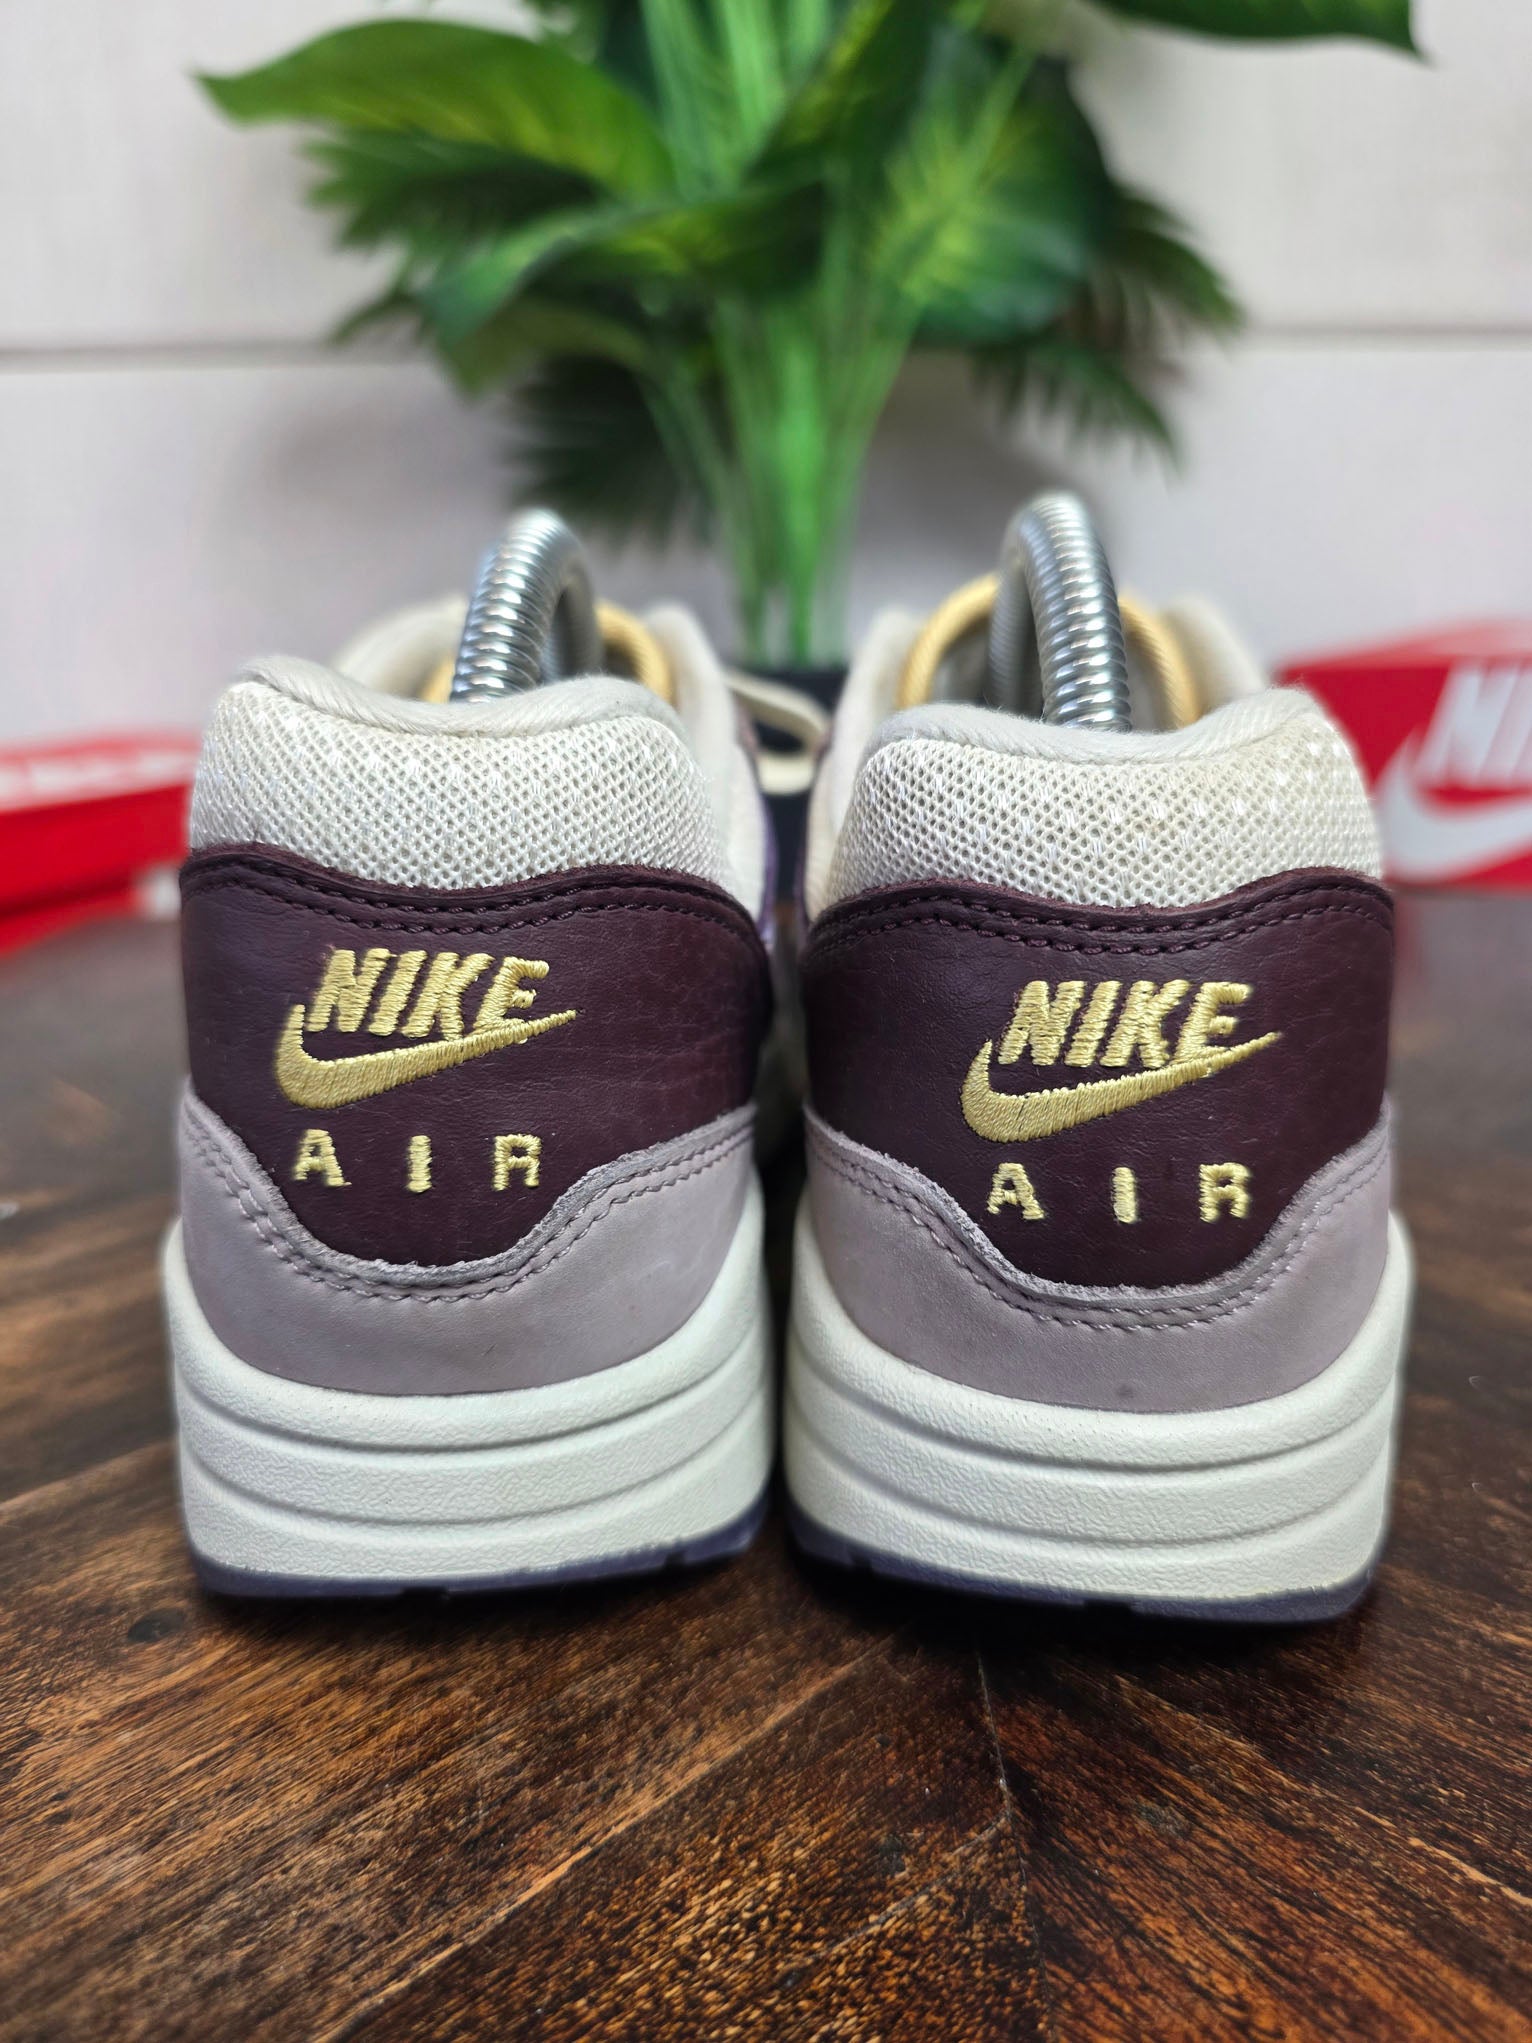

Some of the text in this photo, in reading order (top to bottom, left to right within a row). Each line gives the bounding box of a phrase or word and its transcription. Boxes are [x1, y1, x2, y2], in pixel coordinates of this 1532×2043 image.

[305, 947, 549, 1040] NIKE
[997, 978, 1251, 1067] NIKE
[293, 1128, 542, 1193] AIR
[986, 1161, 1252, 1223] AIR
